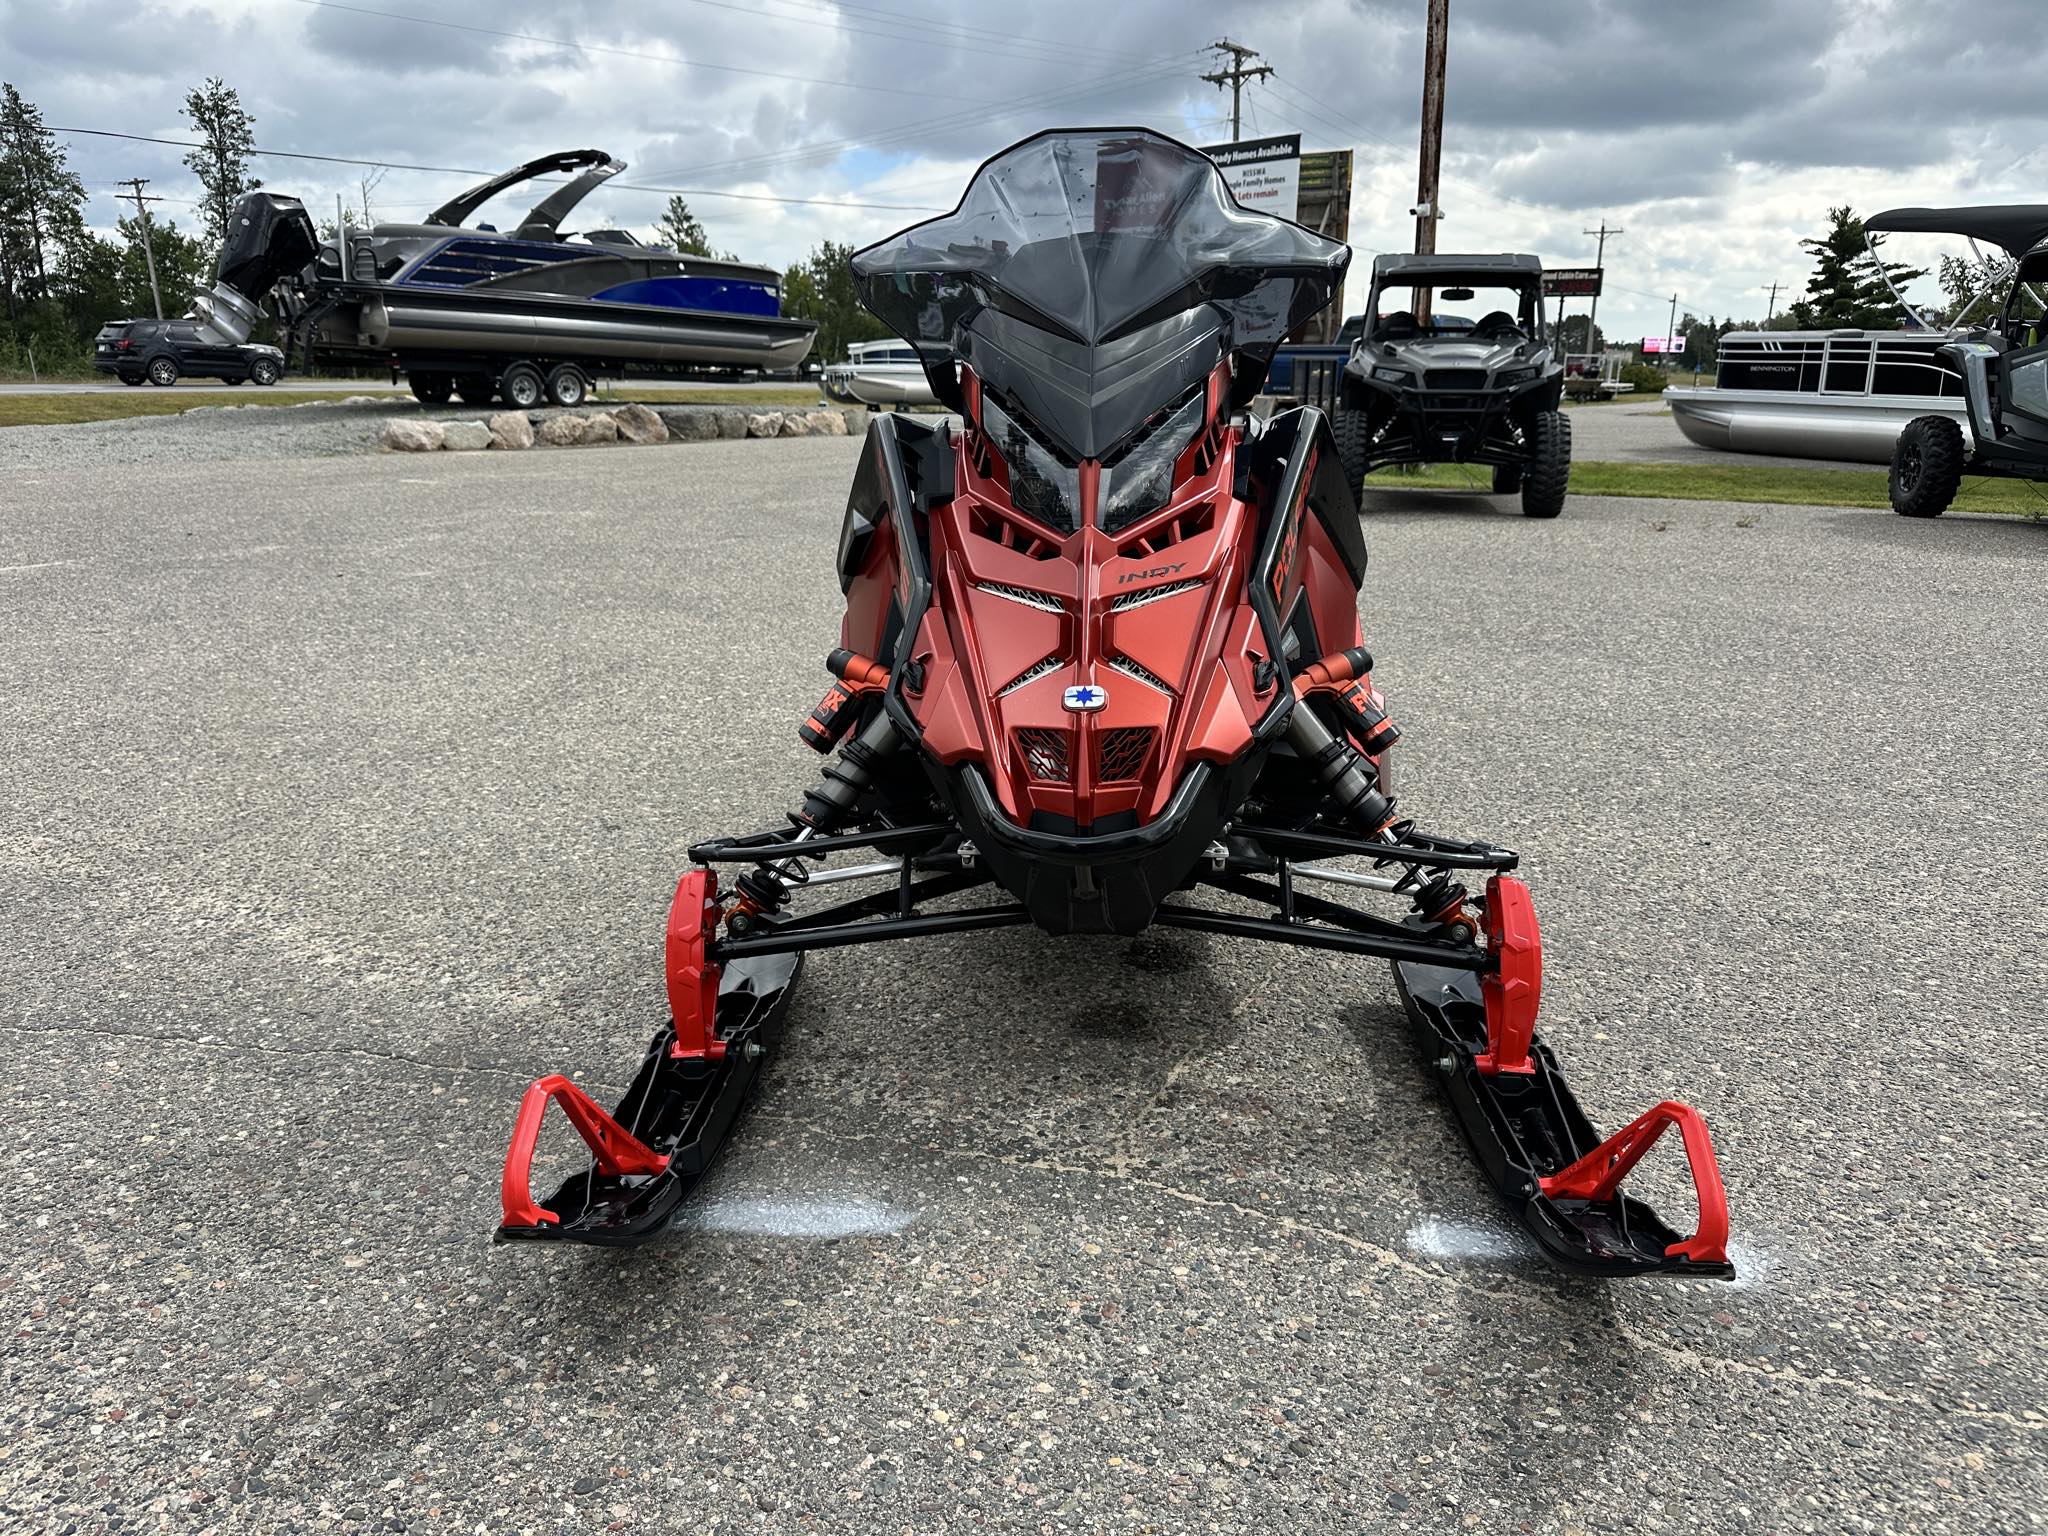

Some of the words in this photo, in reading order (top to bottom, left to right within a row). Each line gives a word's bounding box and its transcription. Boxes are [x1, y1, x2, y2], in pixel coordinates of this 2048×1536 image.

[1232, 150, 1257, 161] Homes
[1257, 143, 1293, 158] Available
[1243, 177, 1263, 188] Family
[1264, 176, 1286, 185] Homes
[1253, 188, 1279, 199] remain
[1118, 561, 1189, 584] INDY
